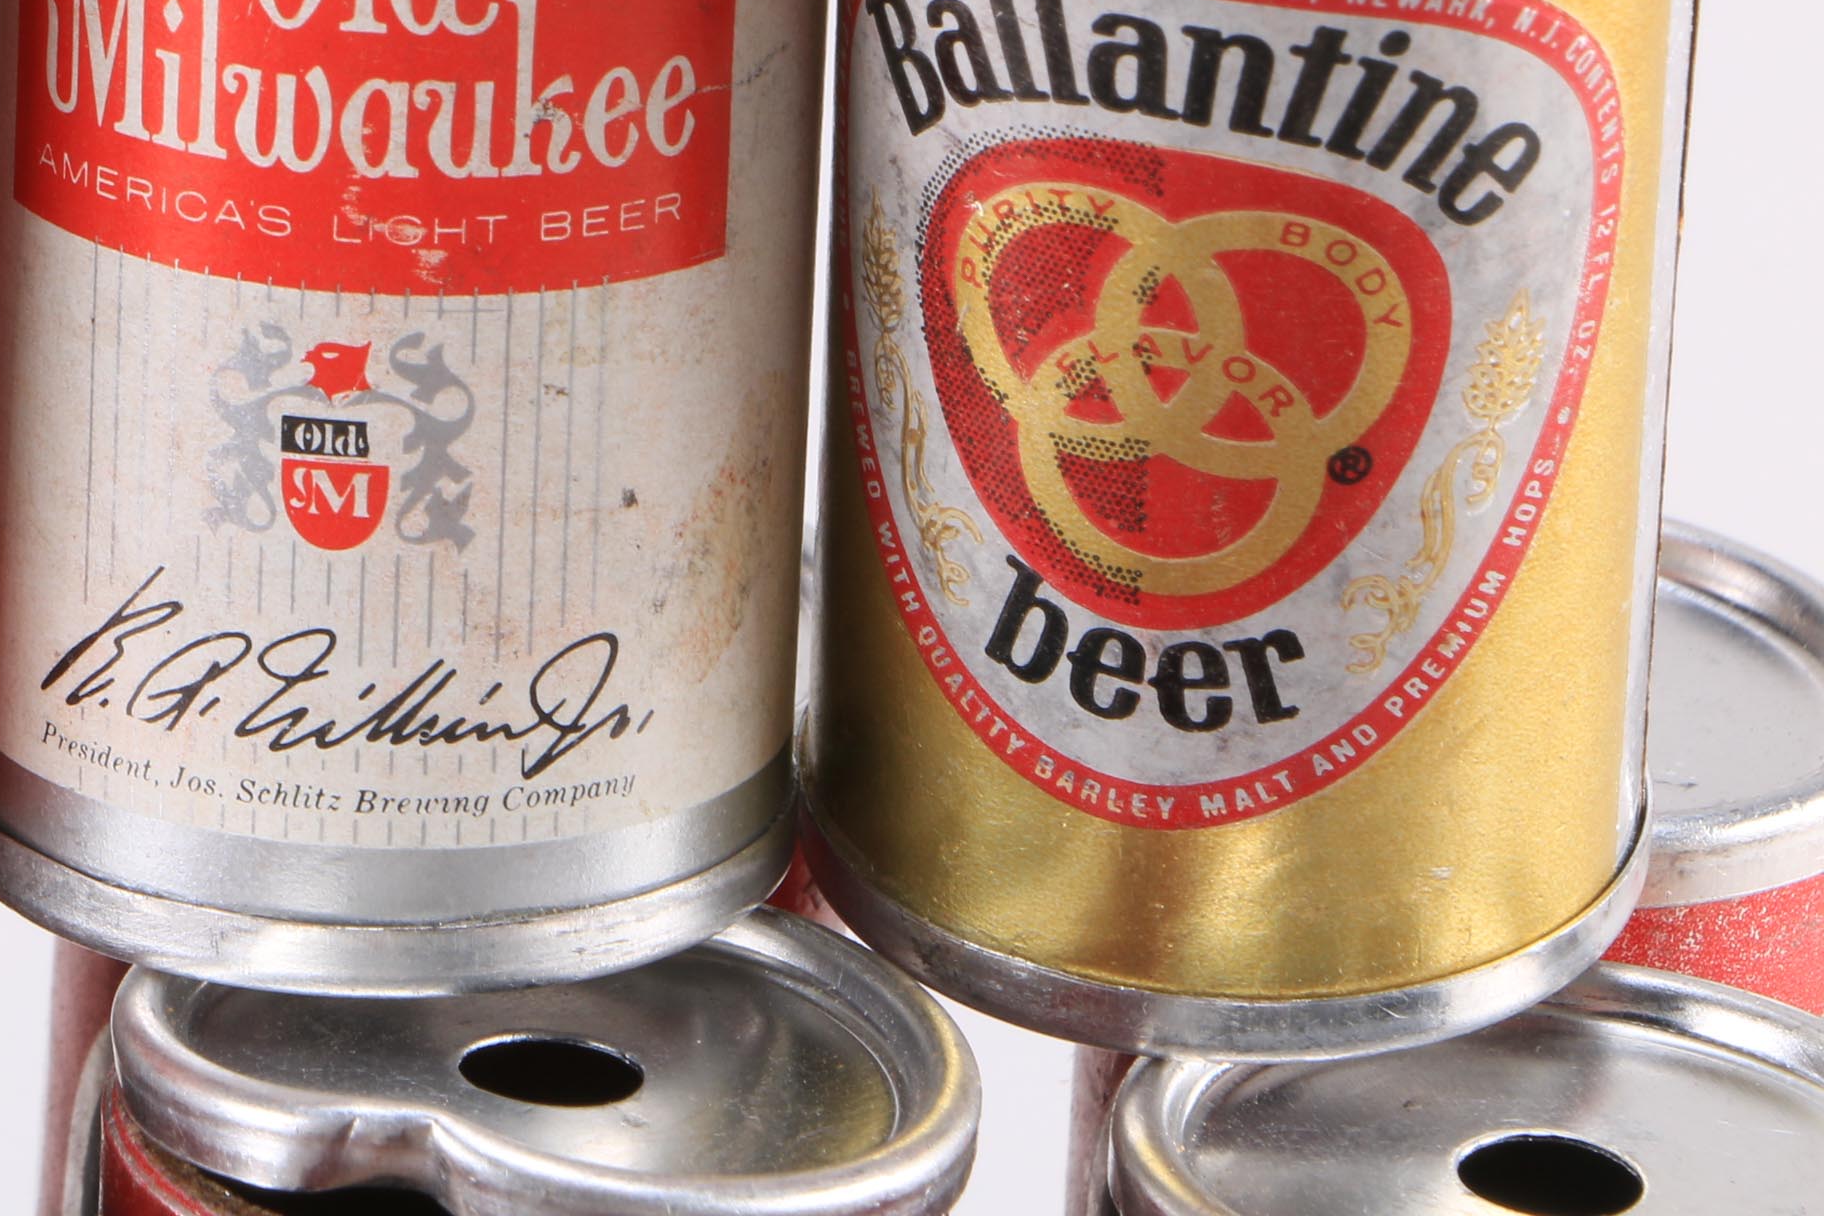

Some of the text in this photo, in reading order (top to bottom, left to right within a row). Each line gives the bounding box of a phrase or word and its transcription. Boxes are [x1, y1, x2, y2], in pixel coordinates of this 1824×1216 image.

[1564, 33, 1622, 184] CONTENTS
[1595, 203, 1617, 239] 12
[39, 142, 683, 247] AMERICA'S LIGHT BEER
[961, 188, 1115, 290] PURITY
[1280, 221, 1404, 331] BODY
[1054, 333, 1295, 418] FLAVOR
[294, 422, 365, 456] Old
[289, 467, 373, 519] M
[878, 520, 921, 613] WITH
[918, 624, 1025, 755] QUALITY
[1033, 754, 1175, 820] BARLEY
[1199, 769, 1295, 819] MALT
[1311, 723, 1378, 777] AND
[1383, 569, 1507, 718] PREMIUM
[985, 554, 1305, 732] beer
[41, 721, 635, 819] President, Jos. Schlitz Brewing Company
